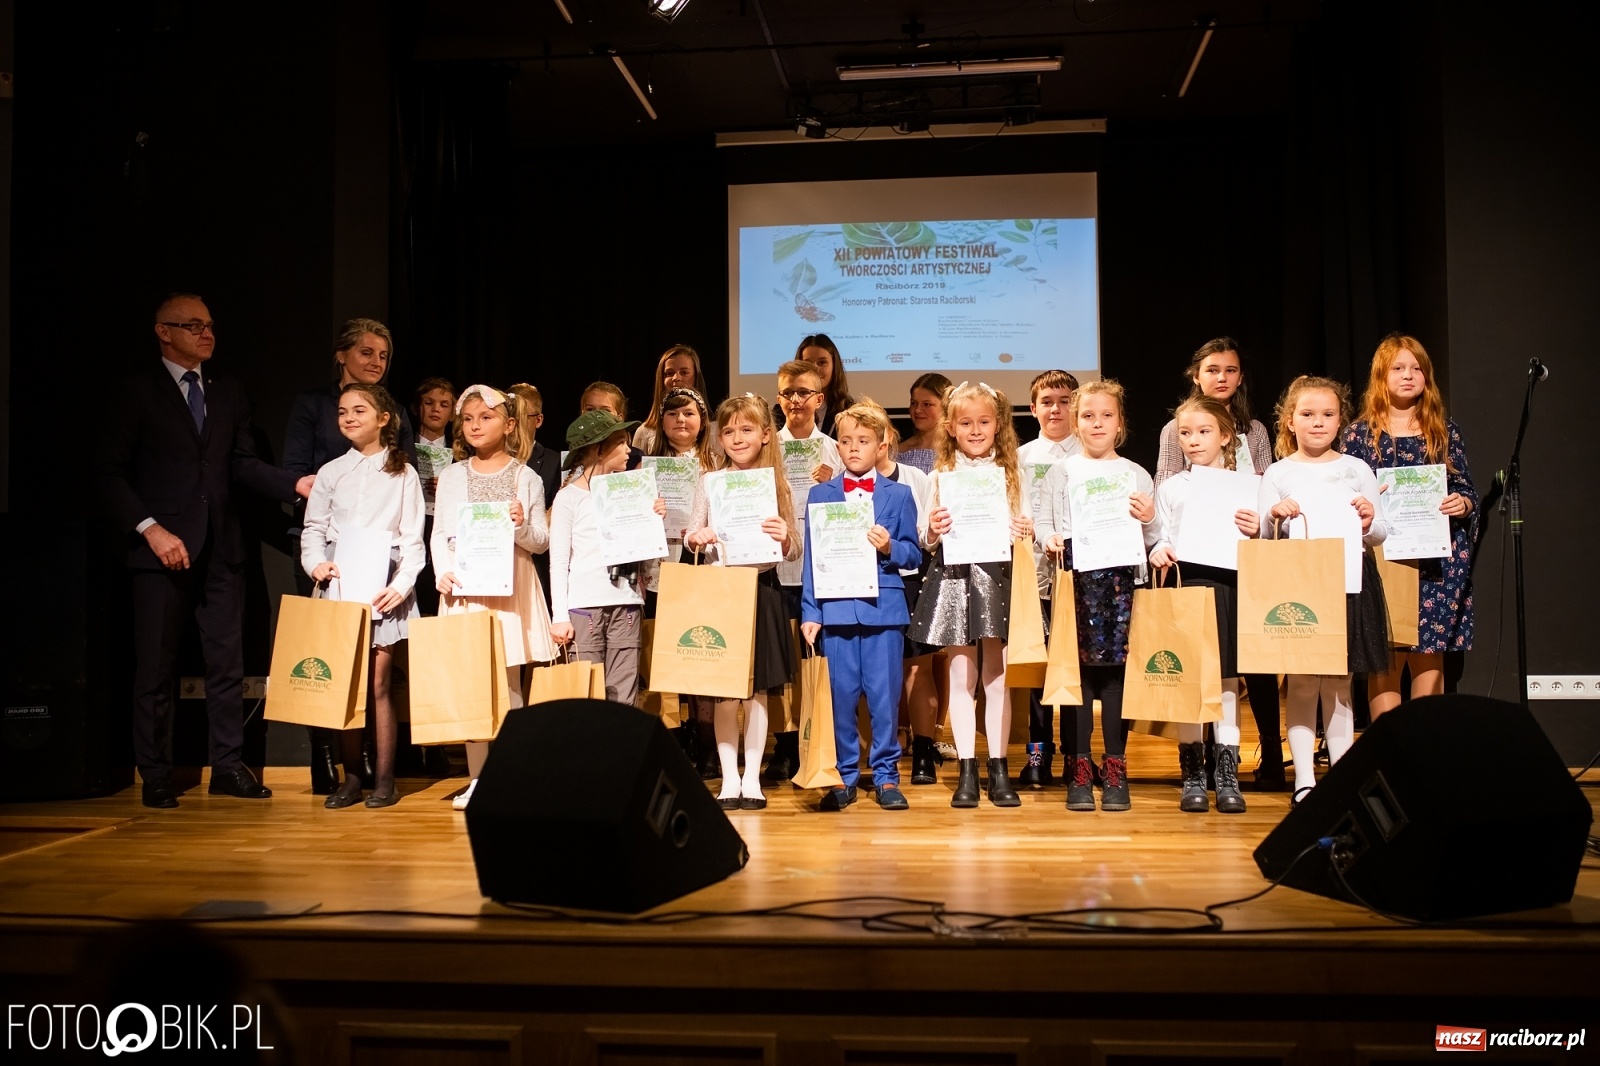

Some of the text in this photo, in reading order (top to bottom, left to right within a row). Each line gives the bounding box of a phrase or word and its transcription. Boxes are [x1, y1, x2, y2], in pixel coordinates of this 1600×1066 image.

[834, 244, 998, 262] XII POWIATOWY FESTIWAL
[840, 262, 991, 276] TWÓRCZOŚCI ARTYSTYCZNEJ
[842, 295, 976, 308] Honorowy Patronat: Starosta Raciborski
[677, 648, 727, 658] KORNOWAC
[289, 678, 332, 690] KORNOWAC
